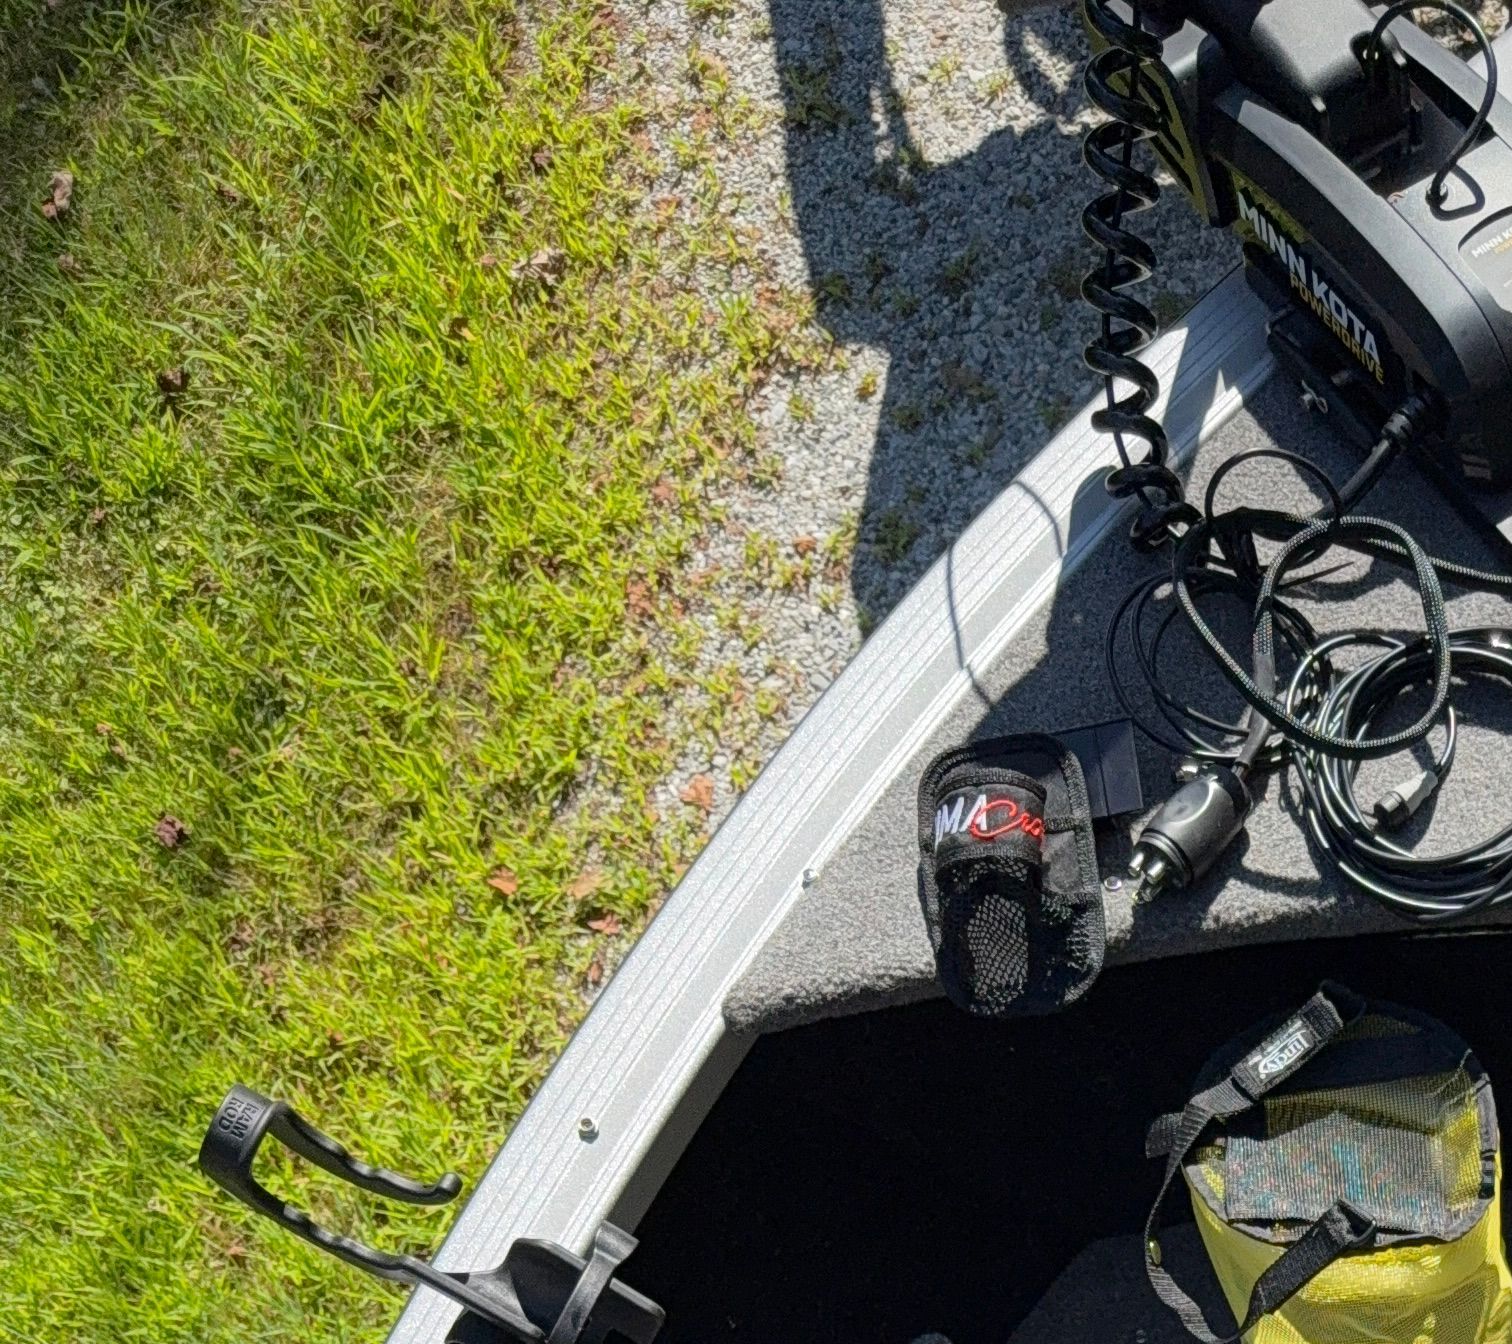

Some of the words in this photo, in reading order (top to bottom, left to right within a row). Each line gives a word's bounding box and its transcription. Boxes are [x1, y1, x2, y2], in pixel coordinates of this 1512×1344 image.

[1471, 234, 1501, 258] MINN
[1237, 190, 1307, 285] MINN
[1311, 269, 1380, 365] KOTA
[1290, 272, 1384, 384] POWERDRIVE
[218, 1097, 245, 1132] ROD
[230, 1102, 260, 1139] RAM
